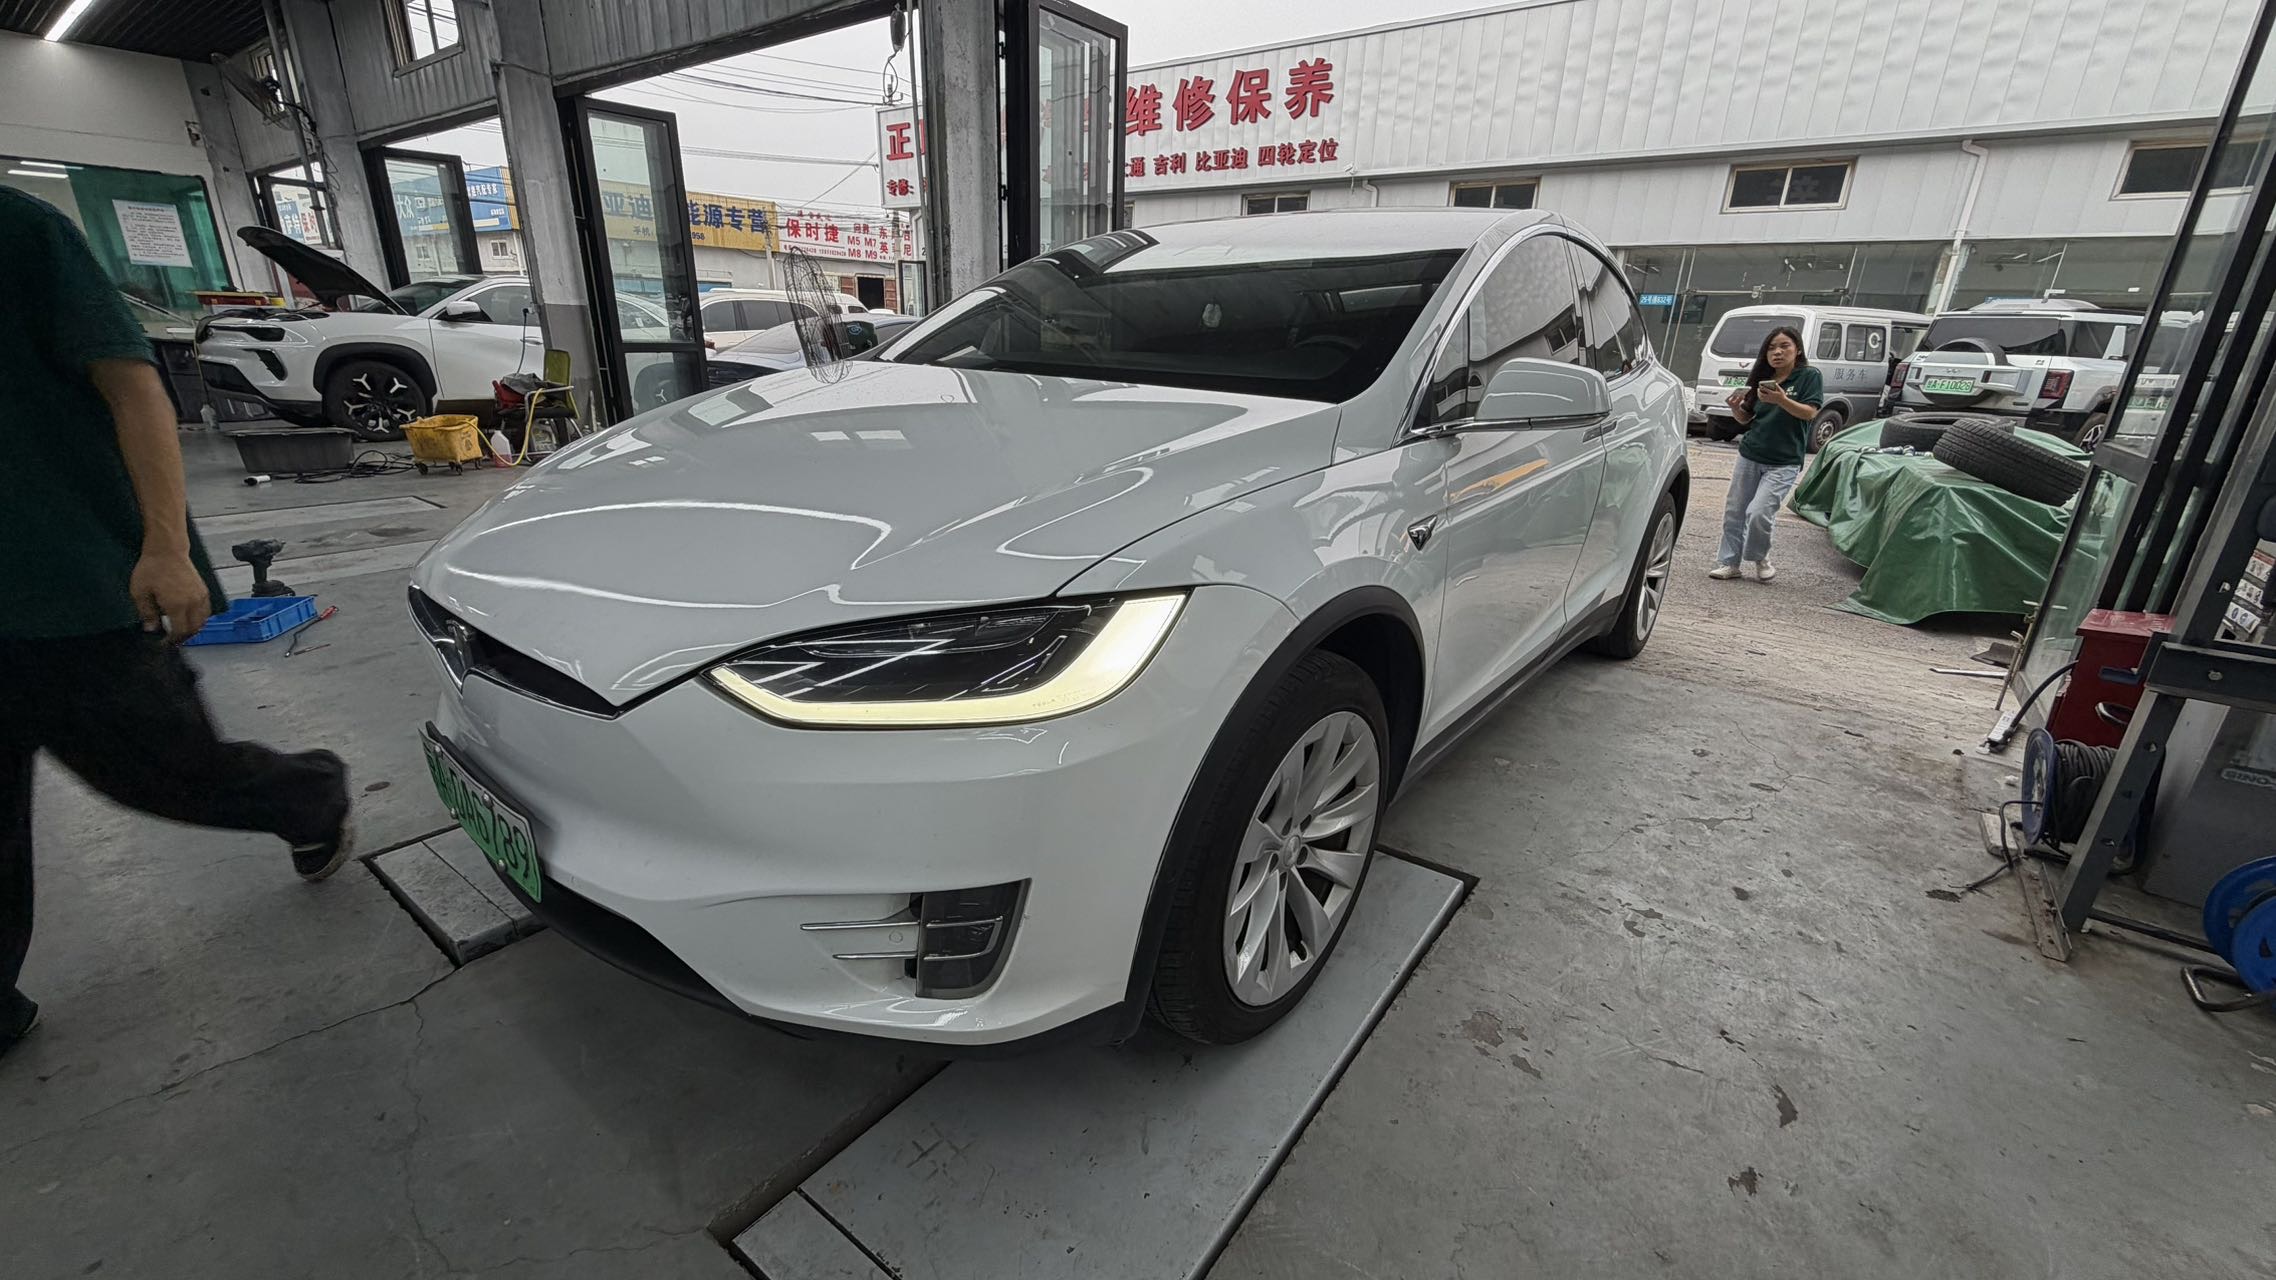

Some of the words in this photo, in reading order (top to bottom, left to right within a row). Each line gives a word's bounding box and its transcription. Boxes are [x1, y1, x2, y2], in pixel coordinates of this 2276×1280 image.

[1126, 57, 1335, 137] 维修保养
[1153, 151, 1187, 176] 吉利
[1195, 146, 1249, 172] 比亚迪
[1257, 137, 1340, 167] 四轮定位
[785, 217, 840, 243] 保时捷
[847, 235, 861, 246] M5
[864, 237, 877, 248] M7
[847, 248, 861, 259] M8
[864, 250, 878, 260] M9
[1833, 367, 1869, 382] 服务车
